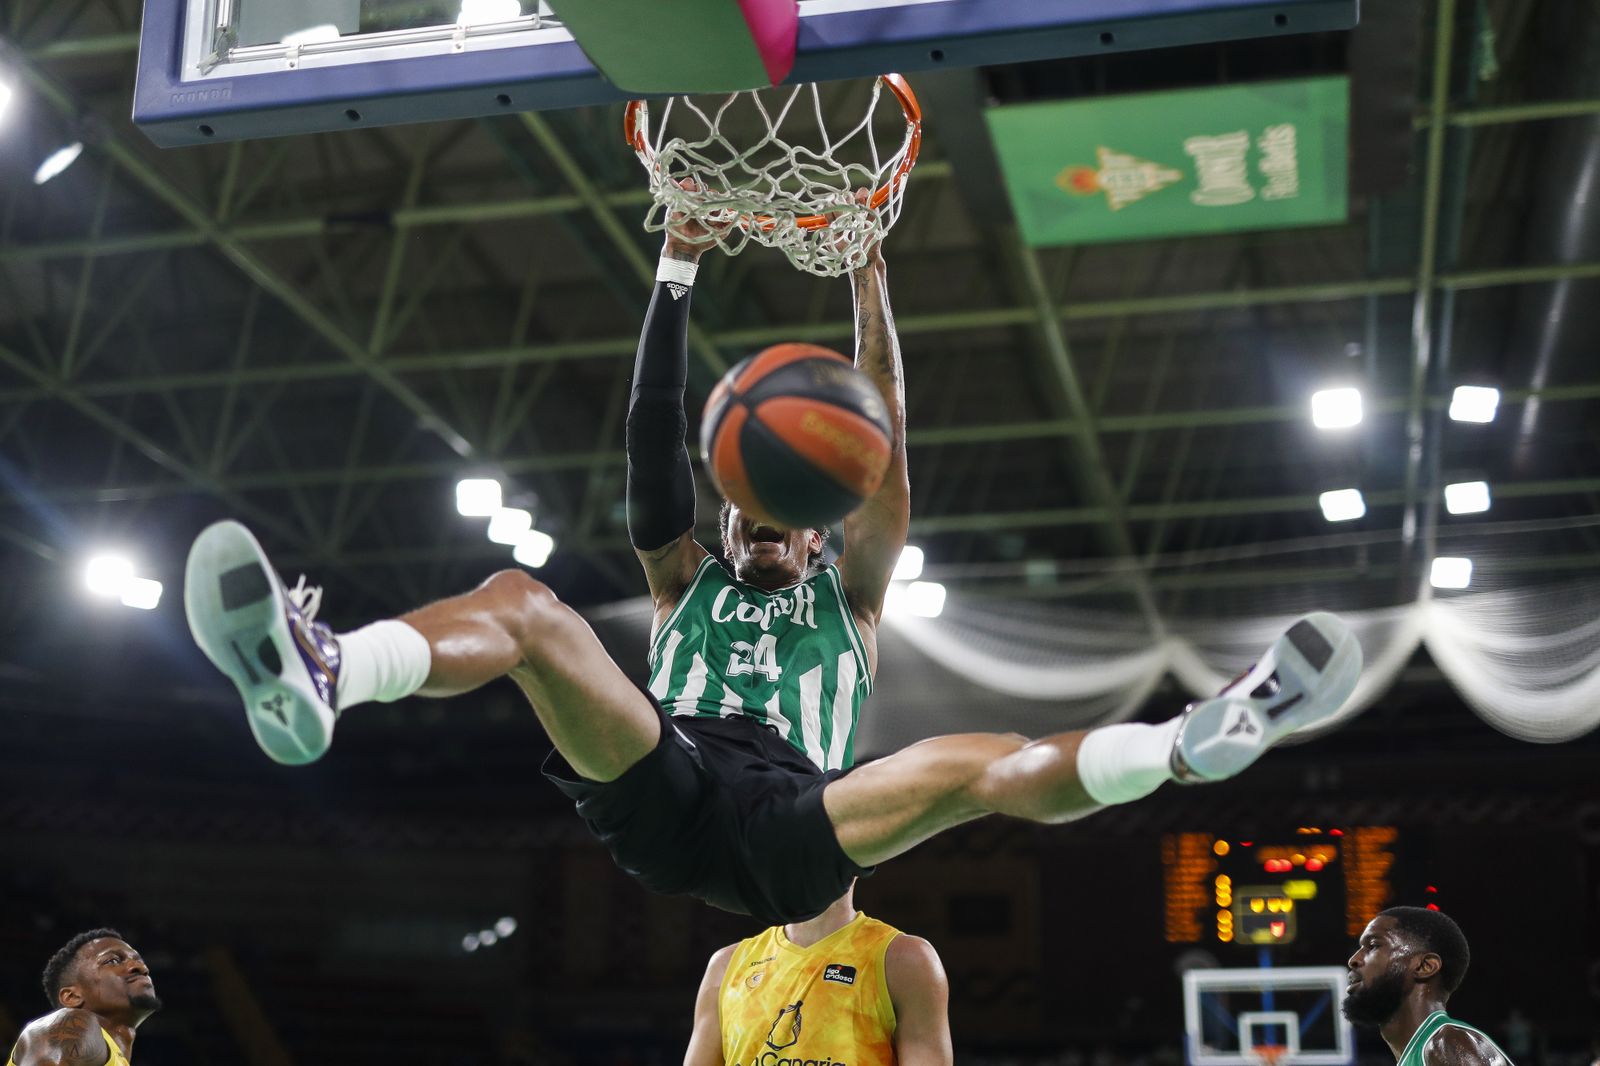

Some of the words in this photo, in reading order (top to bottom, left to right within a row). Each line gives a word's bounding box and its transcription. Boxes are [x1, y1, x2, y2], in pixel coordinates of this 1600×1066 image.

[171, 88, 232, 104] MONDO
[667, 283, 688, 292] adidas
[725, 633, 783, 682] 24
[825, 974, 853, 983] endesa
